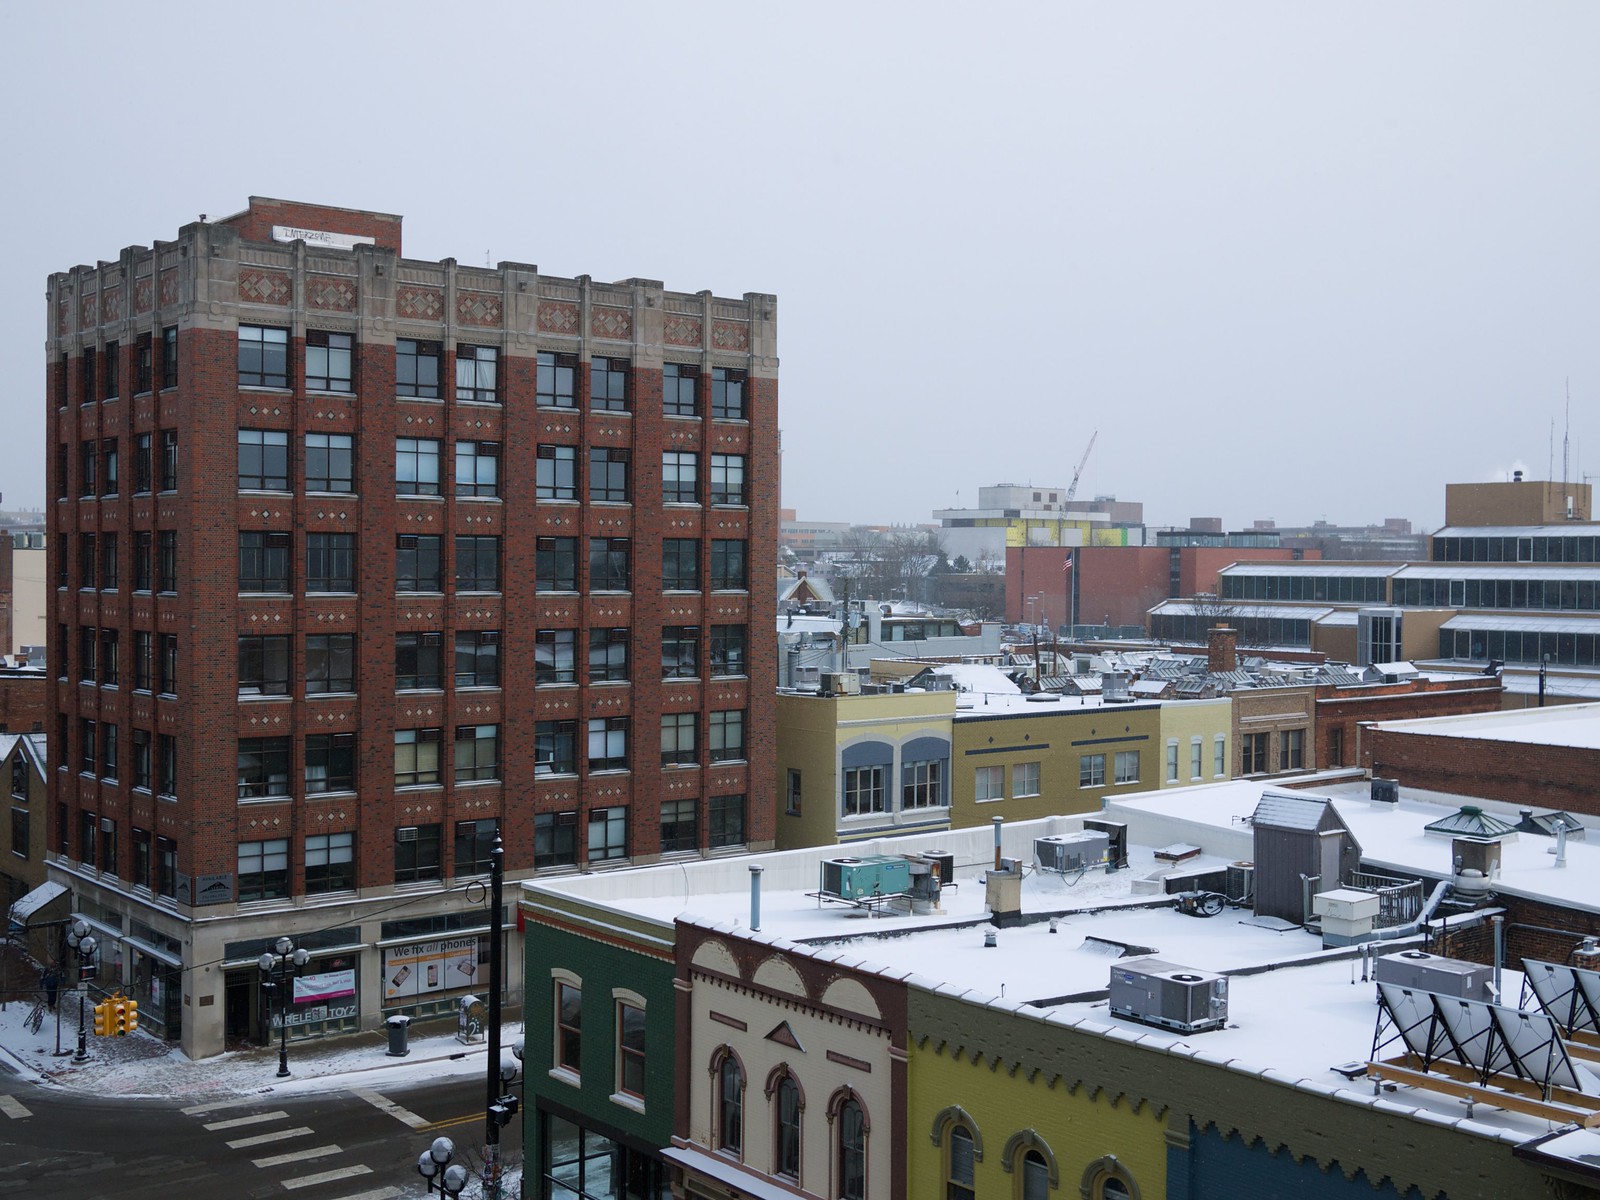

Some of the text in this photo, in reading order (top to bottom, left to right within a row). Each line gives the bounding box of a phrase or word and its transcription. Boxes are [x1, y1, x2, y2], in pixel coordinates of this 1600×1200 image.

[393, 947, 410, 957] We
[412, 945, 424, 954] fix
[426, 941, 438, 951] all
[440, 938, 476, 952] phones
[272, 1005, 357, 1027] WRELESS TOYZ
